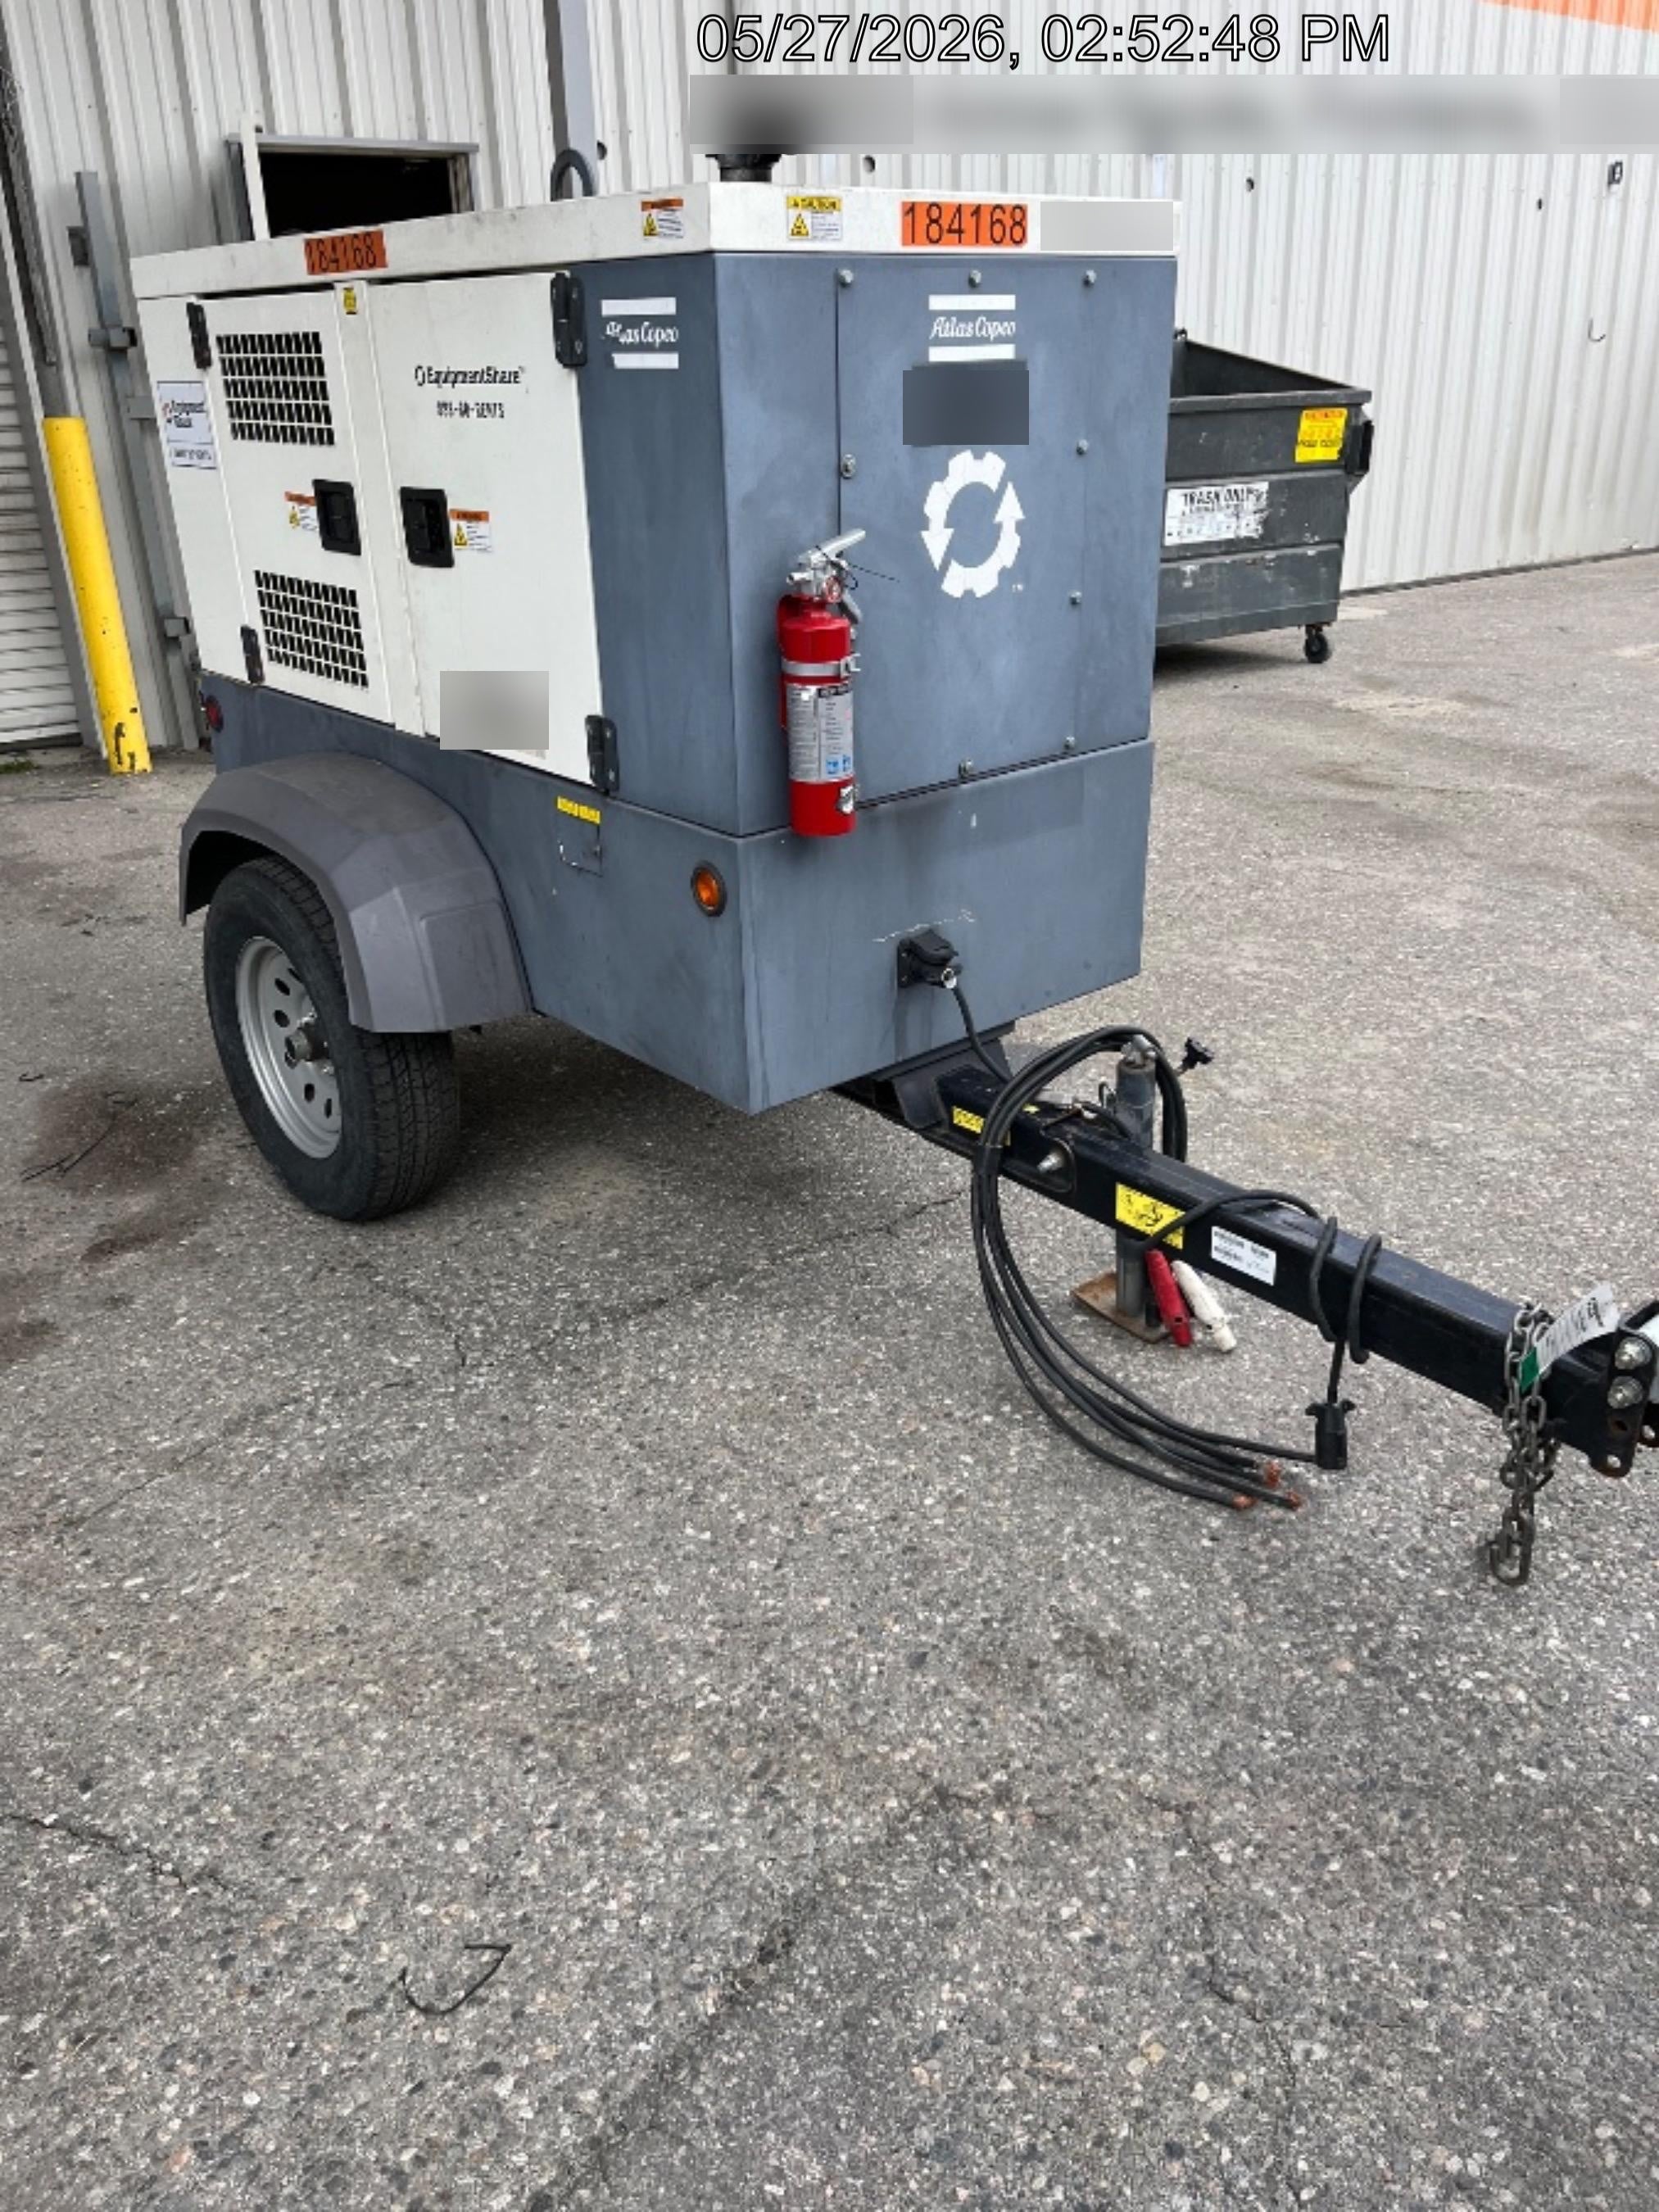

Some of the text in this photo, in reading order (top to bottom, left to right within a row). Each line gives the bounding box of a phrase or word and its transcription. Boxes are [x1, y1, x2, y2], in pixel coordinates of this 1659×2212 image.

[904, 202, 1026, 244] 184168
[306, 232, 378, 273] 184168
[928, 315, 1016, 342] Atlas Copco
